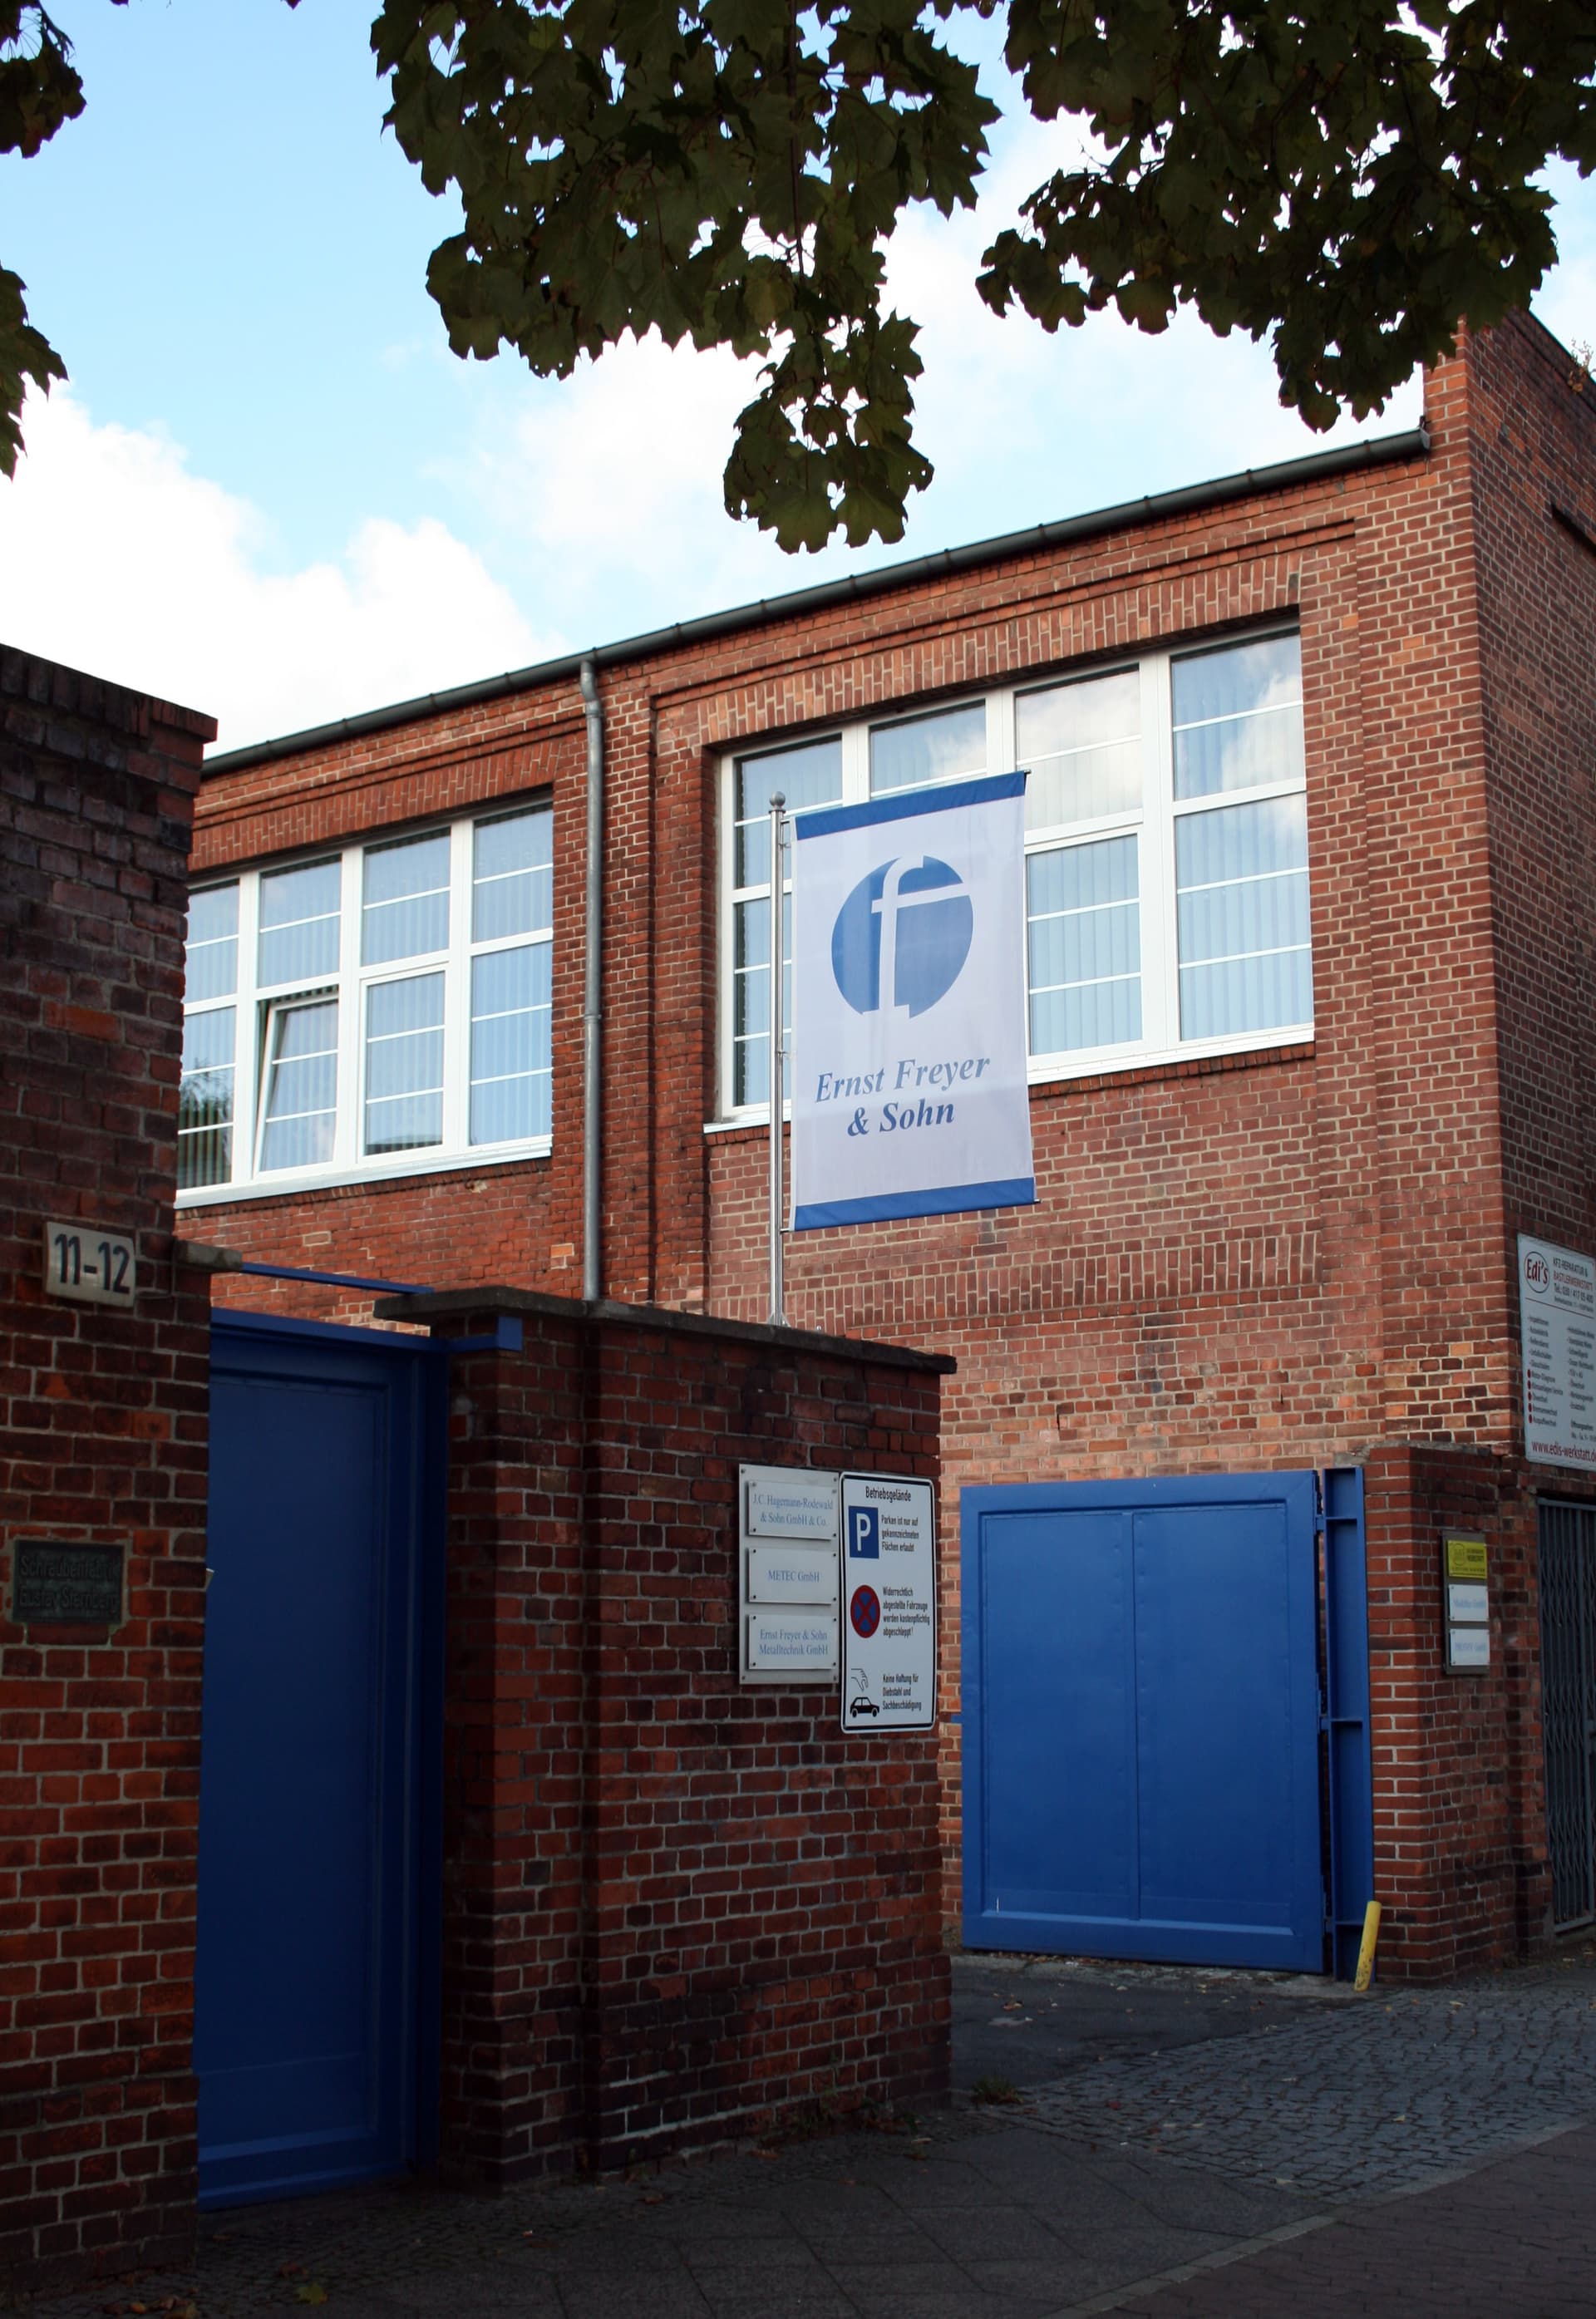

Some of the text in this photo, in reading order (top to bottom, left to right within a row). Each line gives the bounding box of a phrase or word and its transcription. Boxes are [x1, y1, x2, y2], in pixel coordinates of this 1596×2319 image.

[815, 1056, 991, 1103] Ernst Freyer
[847, 1098, 955, 1137] & Sohn
[54, 1233, 131, 1295] 11-12
[1526, 1258, 1549, 1284] Edi's
[767, 1493, 833, 1510] Hagemann-Rodewald
[865, 1486, 911, 1503] Betriebsgelände
[761, 1512, 766, 1523] &
[768, 1512, 785, 1524] Sohn
[786, 1513, 807, 1526] GmbH
[808, 1514, 815, 1526] &
[881, 1514, 896, 1524] Parken
[882, 1529, 919, 1540] gekennzeichneten
[882, 1540, 898, 1551] Flächen
[768, 1569, 820, 1583] METEC GmbH
[883, 1585, 914, 1597] Widerrechtlich
[883, 1599, 928, 1612] abgestellte Fahrzeuge
[883, 1612, 929, 1626] werden kostenpflichtig
[761, 1628, 827, 1643] Ernst Freyer & Sohn
[759, 1643, 828, 1657] Metalltechnik GmbH
[883, 1673, 895, 1683] Keine
[896, 1673, 912, 1686] Haftung
[883, 1686, 911, 1696] Diebstahl und
[883, 1699, 922, 1711] Sachbeschädigung
